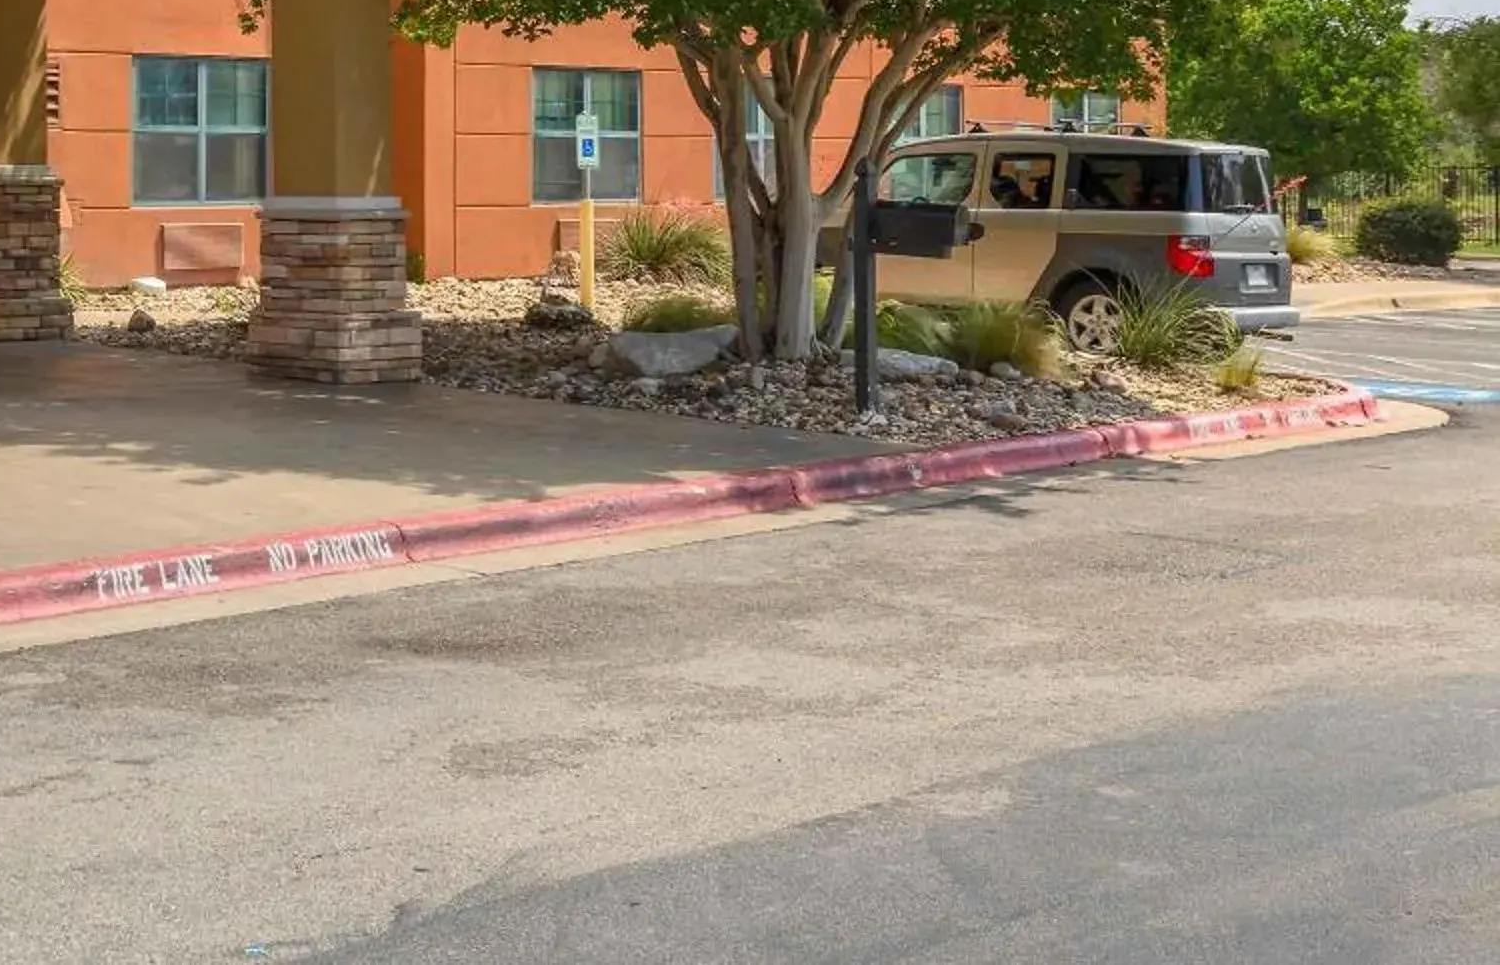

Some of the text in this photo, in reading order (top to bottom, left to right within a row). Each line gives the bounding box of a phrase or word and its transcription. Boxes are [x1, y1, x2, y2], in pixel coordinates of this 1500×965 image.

[96, 529, 394, 601] FIRE LANE NO PARKING
